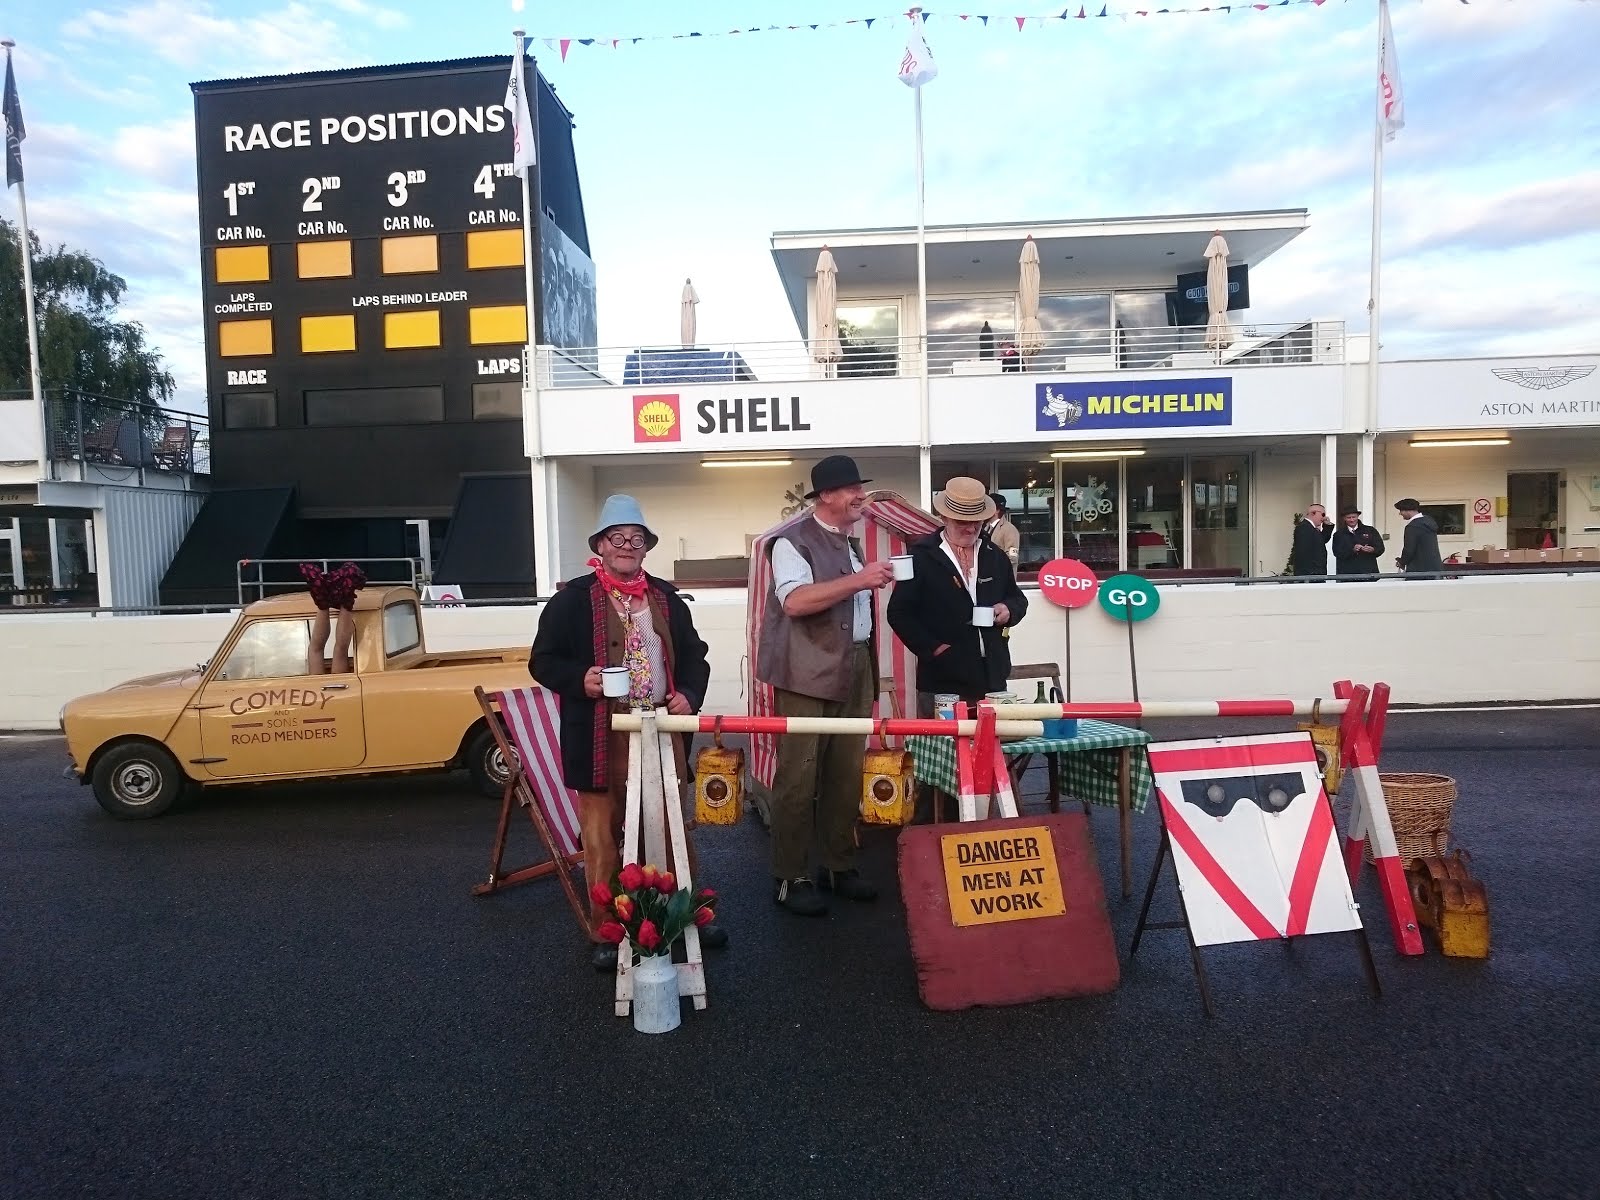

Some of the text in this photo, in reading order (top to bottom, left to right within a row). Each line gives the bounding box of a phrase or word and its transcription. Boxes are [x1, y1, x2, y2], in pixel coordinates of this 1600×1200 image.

[224, 119, 312, 152] RACE
[321, 104, 506, 145] POSITIONS
[387, 169, 427, 207] 3RD
[473, 162, 514, 199] 4TH
[223, 181, 256, 217] 1ST
[302, 176, 341, 213] 2ND
[383, 215, 434, 231] CAR No.
[468, 208, 520, 225] CAR No.
[217, 226, 266, 241] CAR No.
[298, 220, 348, 236] CAR No.
[230, 293, 256, 303] LAPS
[352, 290, 468, 307] LAPS BEHIND LEADER
[215, 302, 273, 313] COMPLETED
[477, 358, 521, 375] LAPS
[227, 369, 267, 386] RACE
[1087, 392, 1225, 415] MICHELIN
[1480, 402, 1534, 416] ASTON
[644, 414, 670, 423] SHELL
[696, 396, 811, 434] SHELL
[1043, 574, 1093, 591] STOP
[1108, 588, 1147, 606] GO
[266, 717, 298, 729] SONS
[231, 728, 338, 745] ROAD MENDERS
[957, 837, 1040, 864] DANGER
[962, 867, 1046, 892] MEN AT
[970, 891, 1044, 915] WORK
